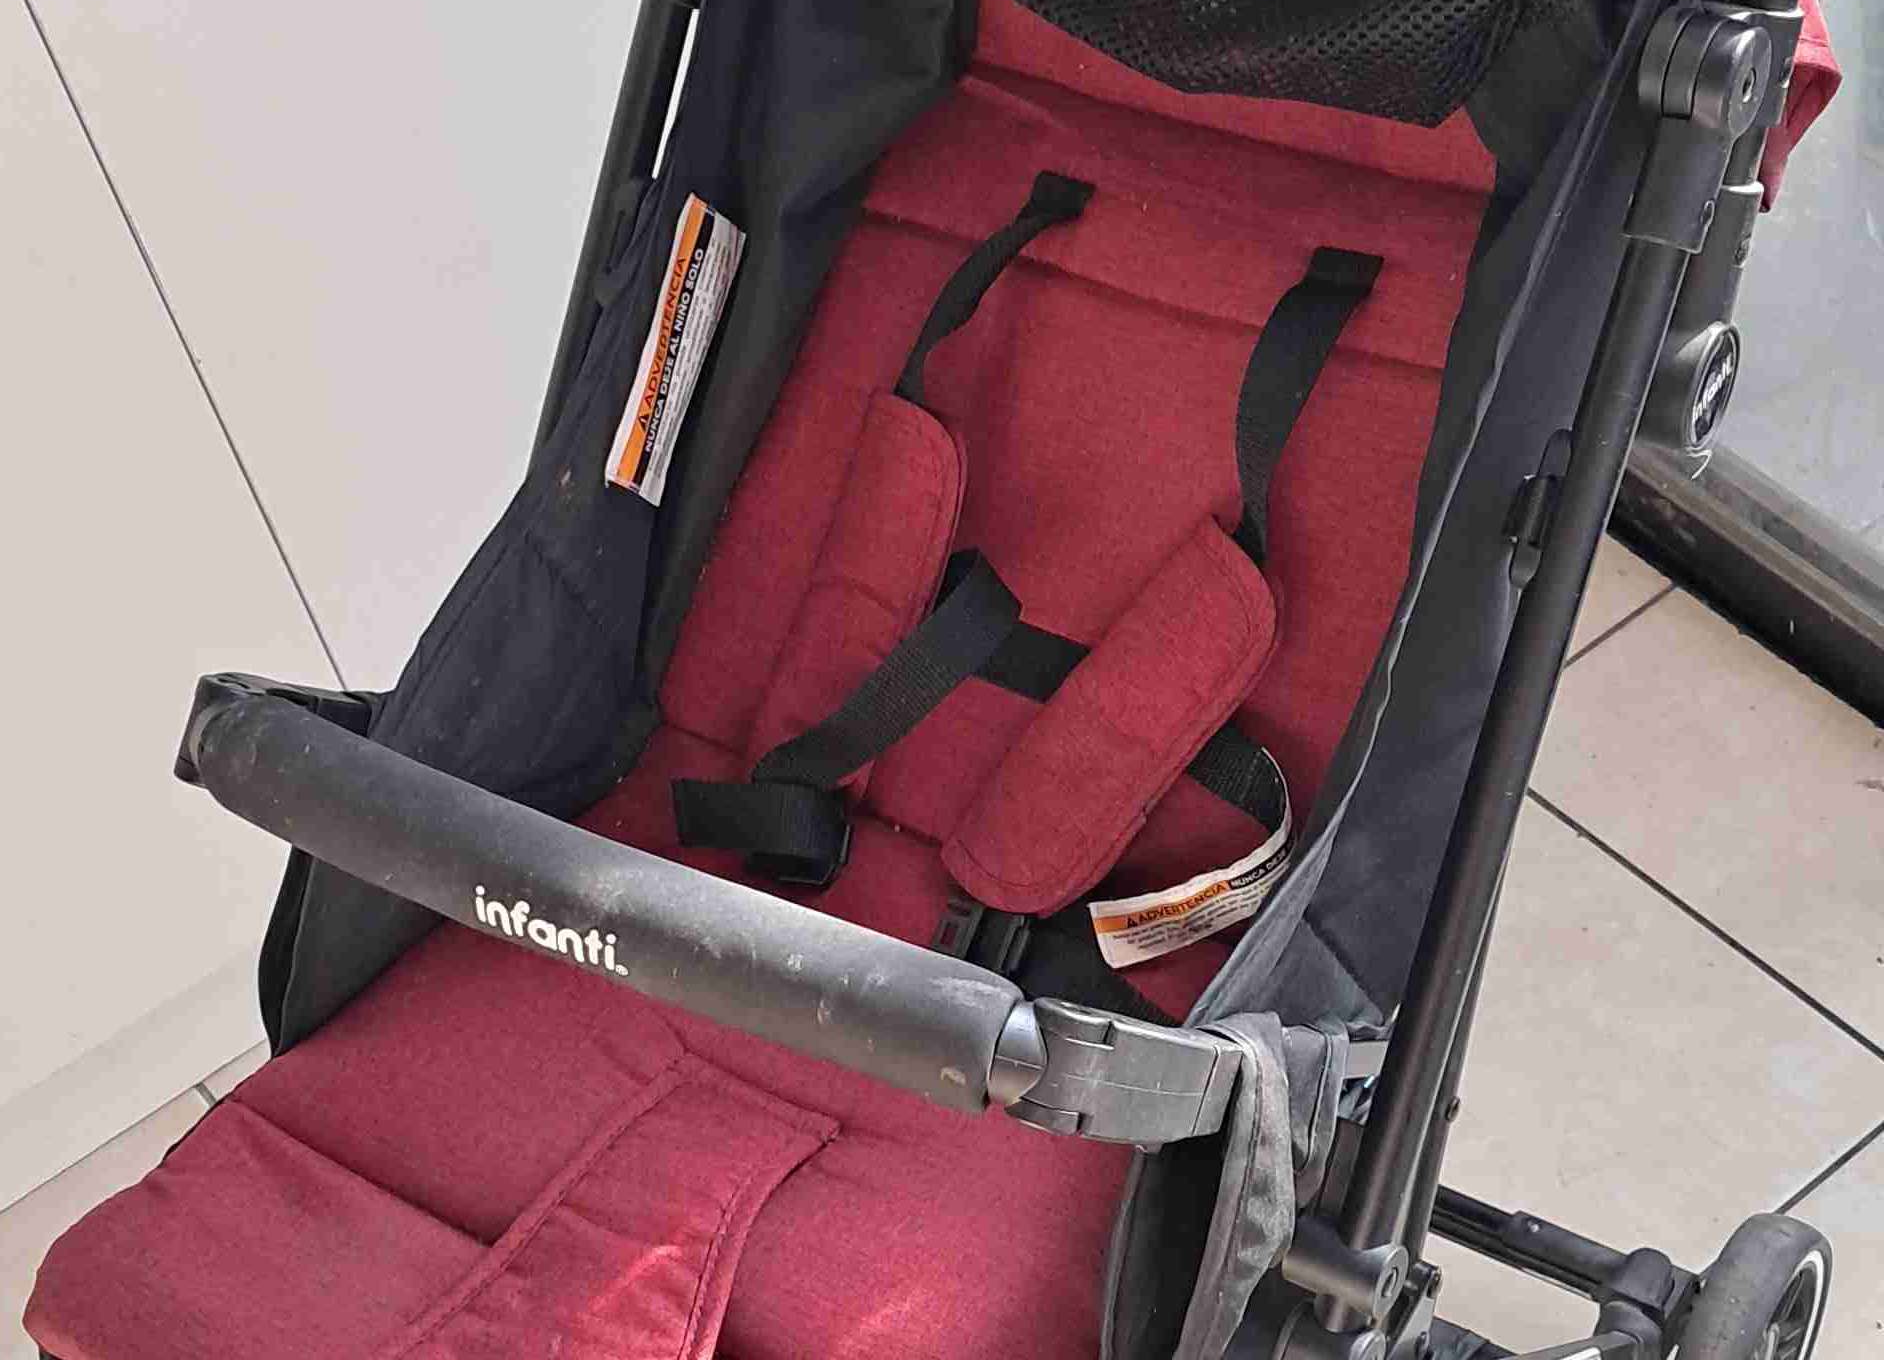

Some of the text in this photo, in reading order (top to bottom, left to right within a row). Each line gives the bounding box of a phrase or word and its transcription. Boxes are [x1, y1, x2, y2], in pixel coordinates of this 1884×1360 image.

[645, 258, 686, 408] ADVERTENCIA
[645, 399, 665, 453] NUNCA
[660, 357, 674, 395] DEJE
[669, 335, 680, 356] AL
[685, 248, 704, 290] SOLO
[475, 885, 618, 972] infanti
[1138, 883, 1227, 924] ADVERTENCIA
[1230, 868, 1266, 888] NUNCA
